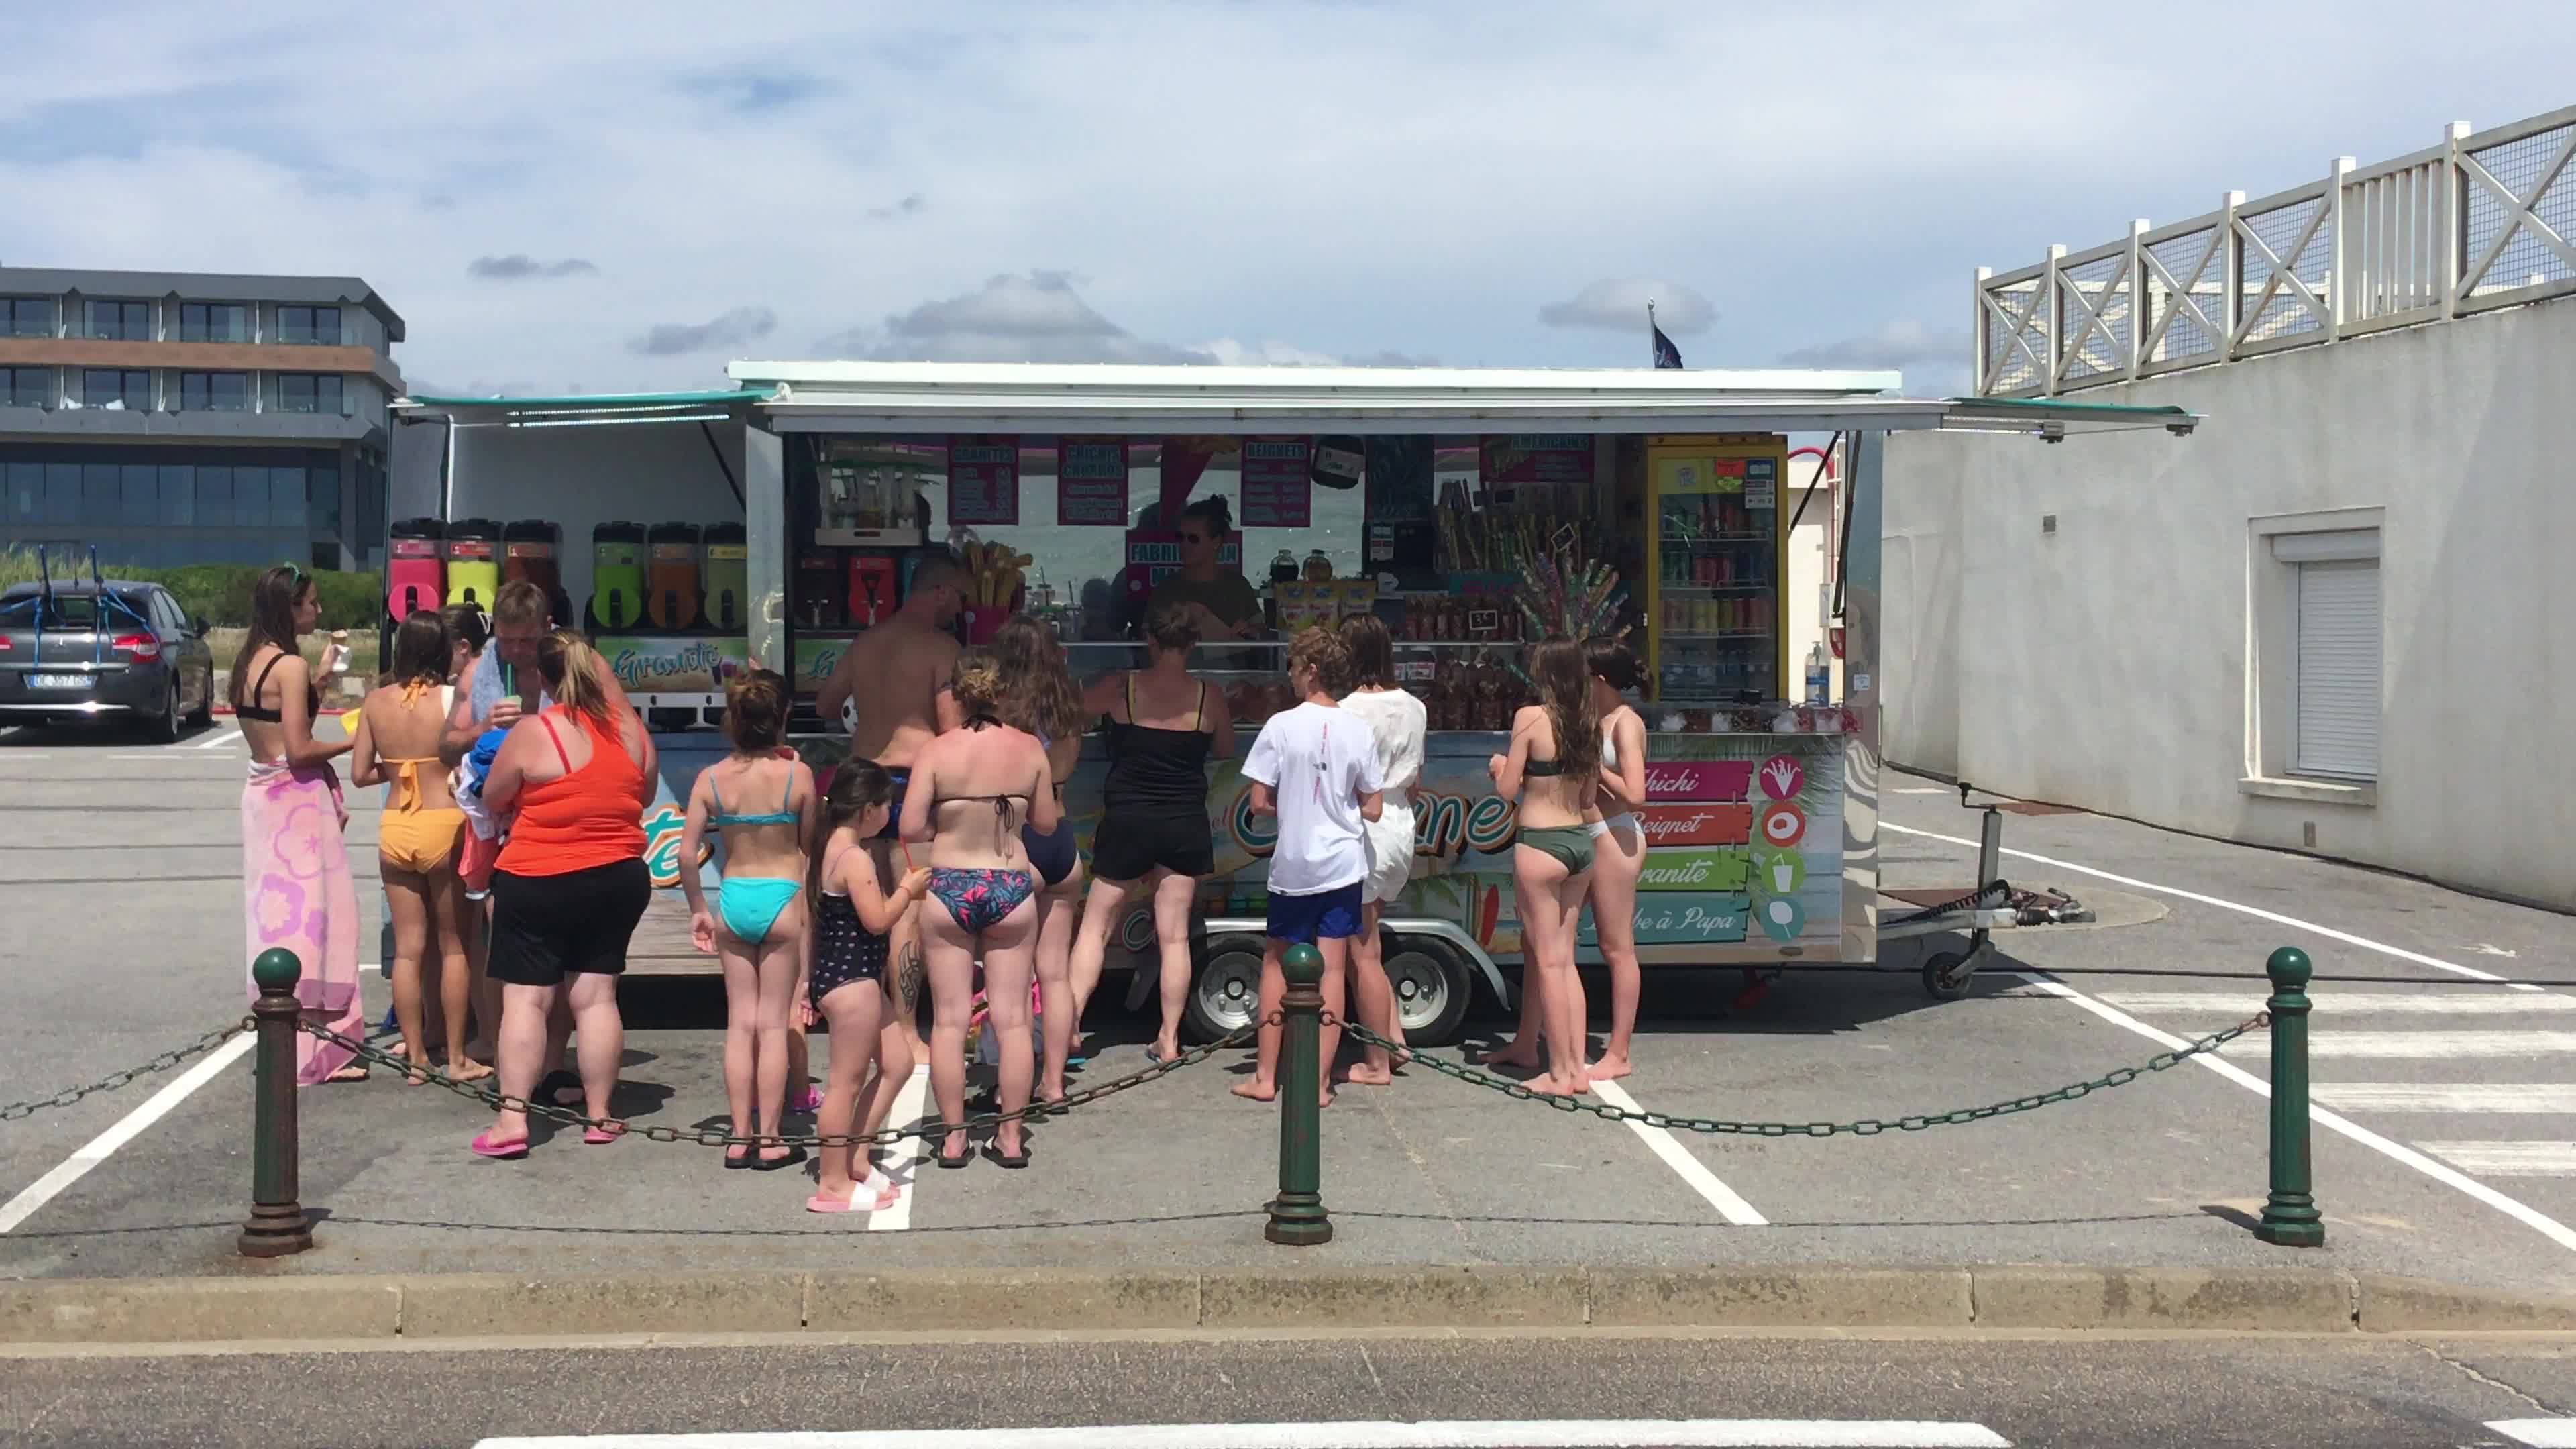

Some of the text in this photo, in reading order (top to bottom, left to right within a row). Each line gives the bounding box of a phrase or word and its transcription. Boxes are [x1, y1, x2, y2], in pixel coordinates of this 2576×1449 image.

[1645, 768, 1699, 792] hichi
[1638, 859, 1715, 883] ranite
[1676, 906, 1737, 936] Papa
